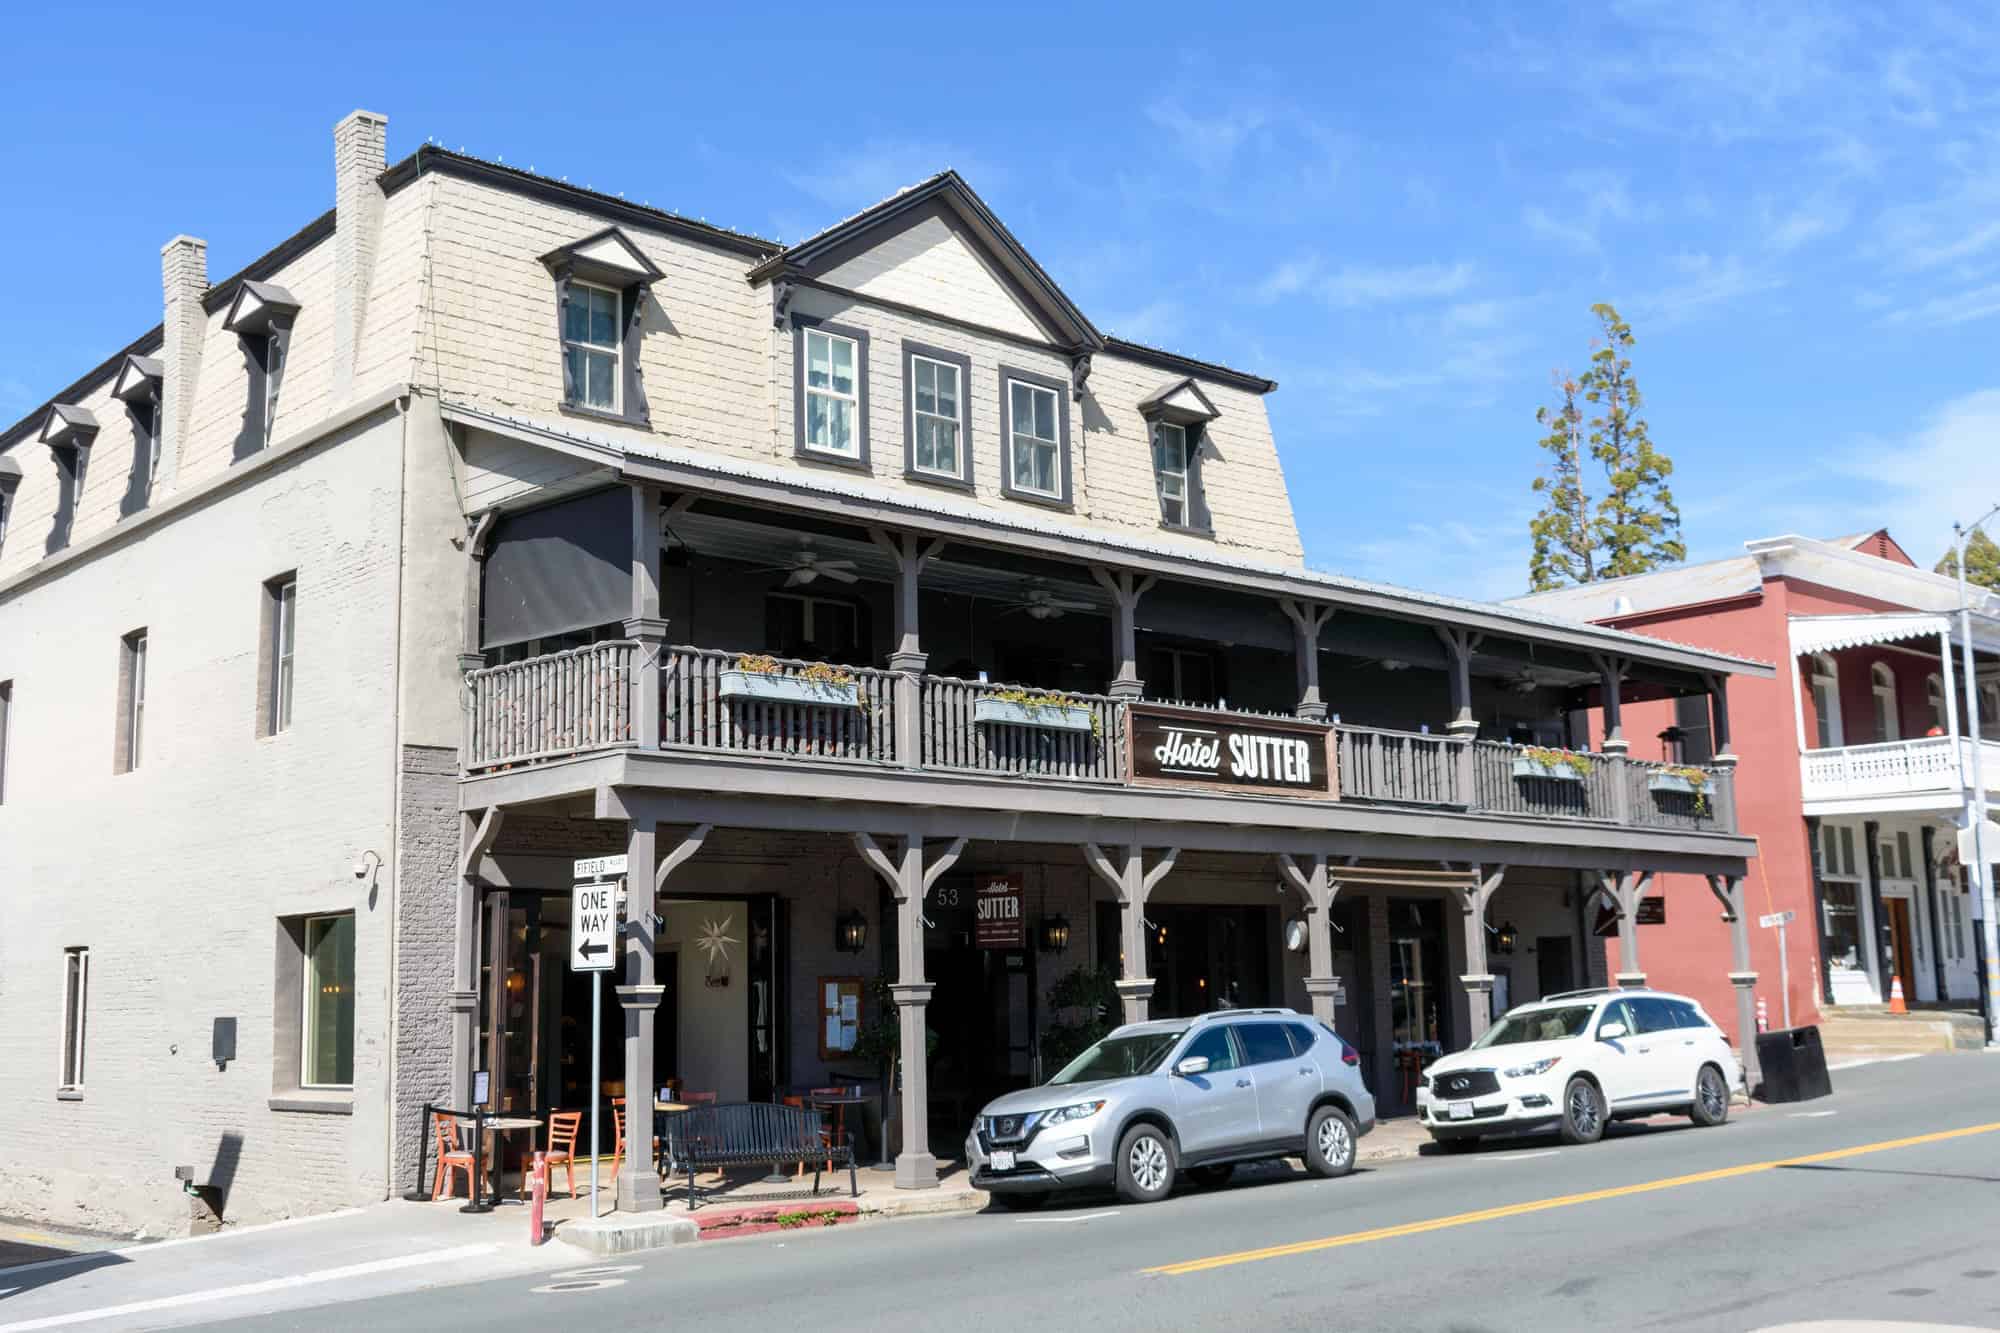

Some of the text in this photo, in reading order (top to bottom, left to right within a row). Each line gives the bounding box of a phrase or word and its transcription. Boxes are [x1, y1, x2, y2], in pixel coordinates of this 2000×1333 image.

[1155, 732, 1311, 783] Hotel SUTTER
[577, 860, 605, 873] FIFIELD
[988, 881, 1009, 893] Hotel
[581, 891, 608, 910] ONE
[937, 888, 959, 906] 53
[977, 896, 1019, 920] SUTTER
[581, 914, 608, 932] WAY
